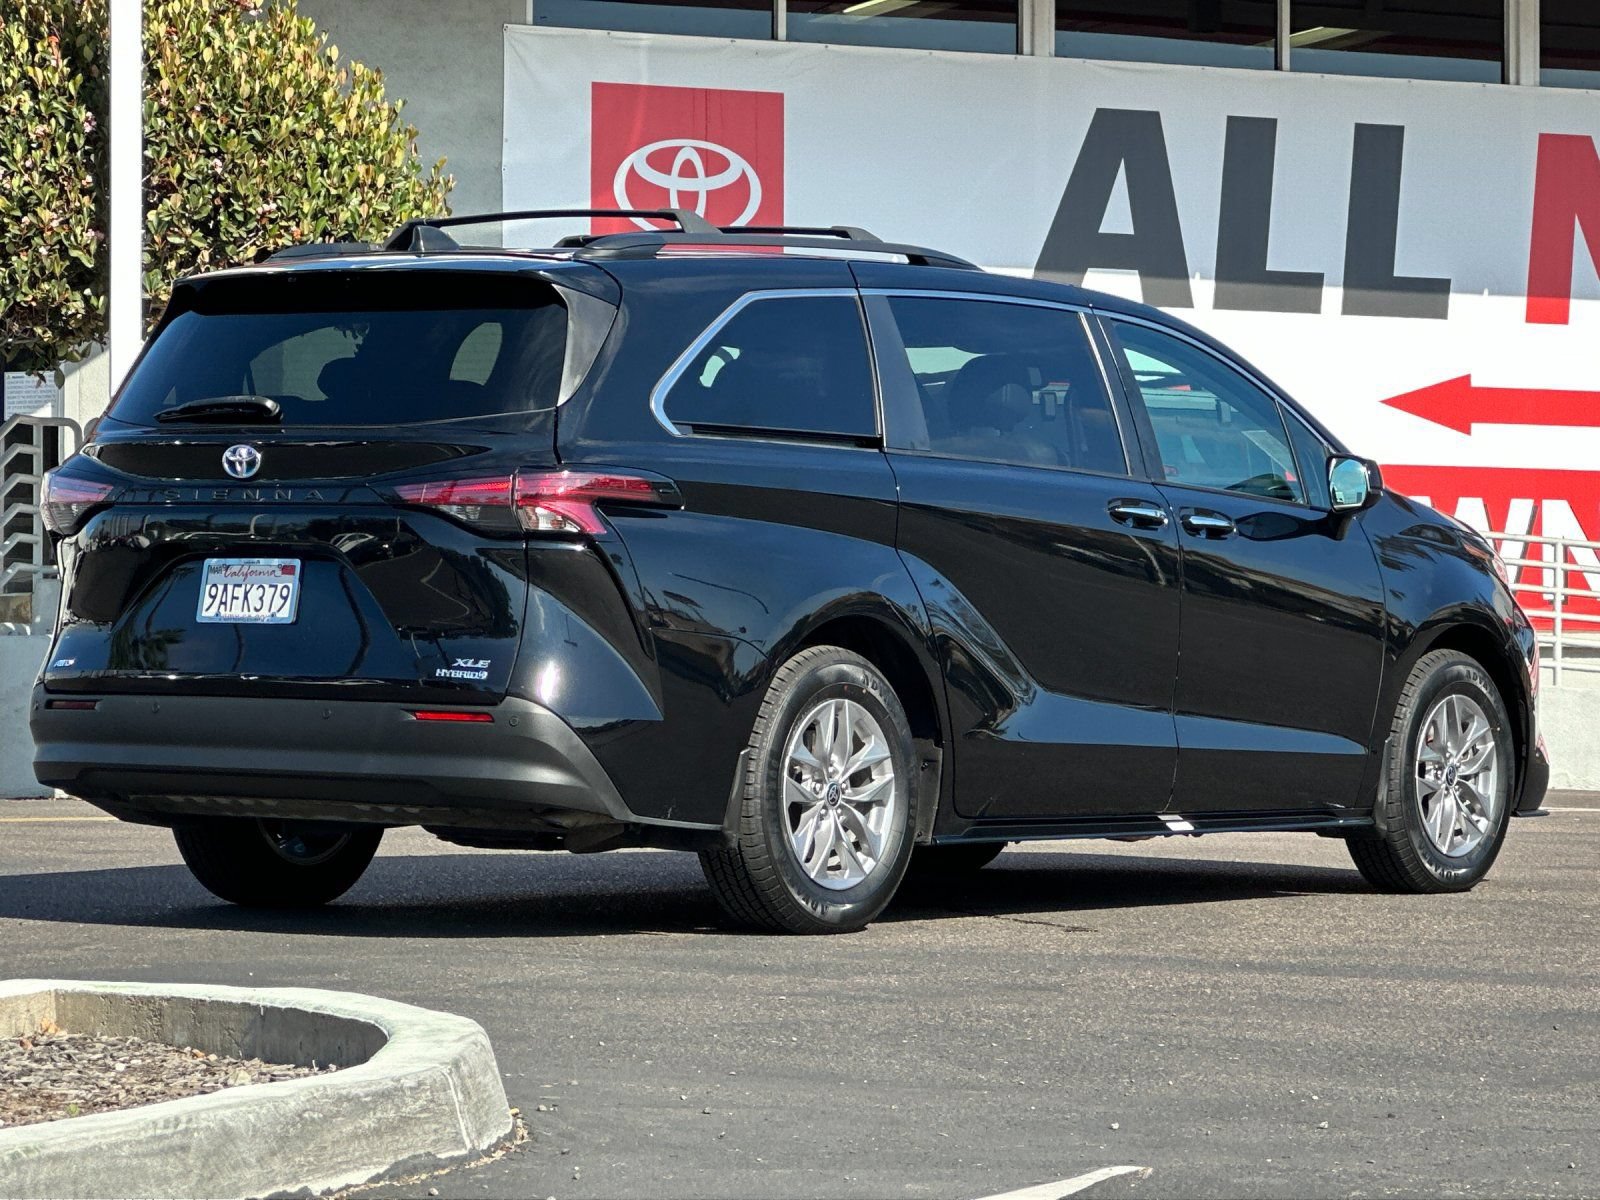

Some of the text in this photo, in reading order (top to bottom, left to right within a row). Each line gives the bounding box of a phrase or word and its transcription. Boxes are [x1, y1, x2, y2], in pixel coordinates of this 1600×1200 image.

[1033, 108, 1452, 320] ALL
[163, 488, 325, 501] SIENNA
[222, 564, 282, 582] California
[204, 583, 291, 613] 9AFK379
[451, 657, 491, 669] XLE
[435, 668, 480, 679] HYBRID
